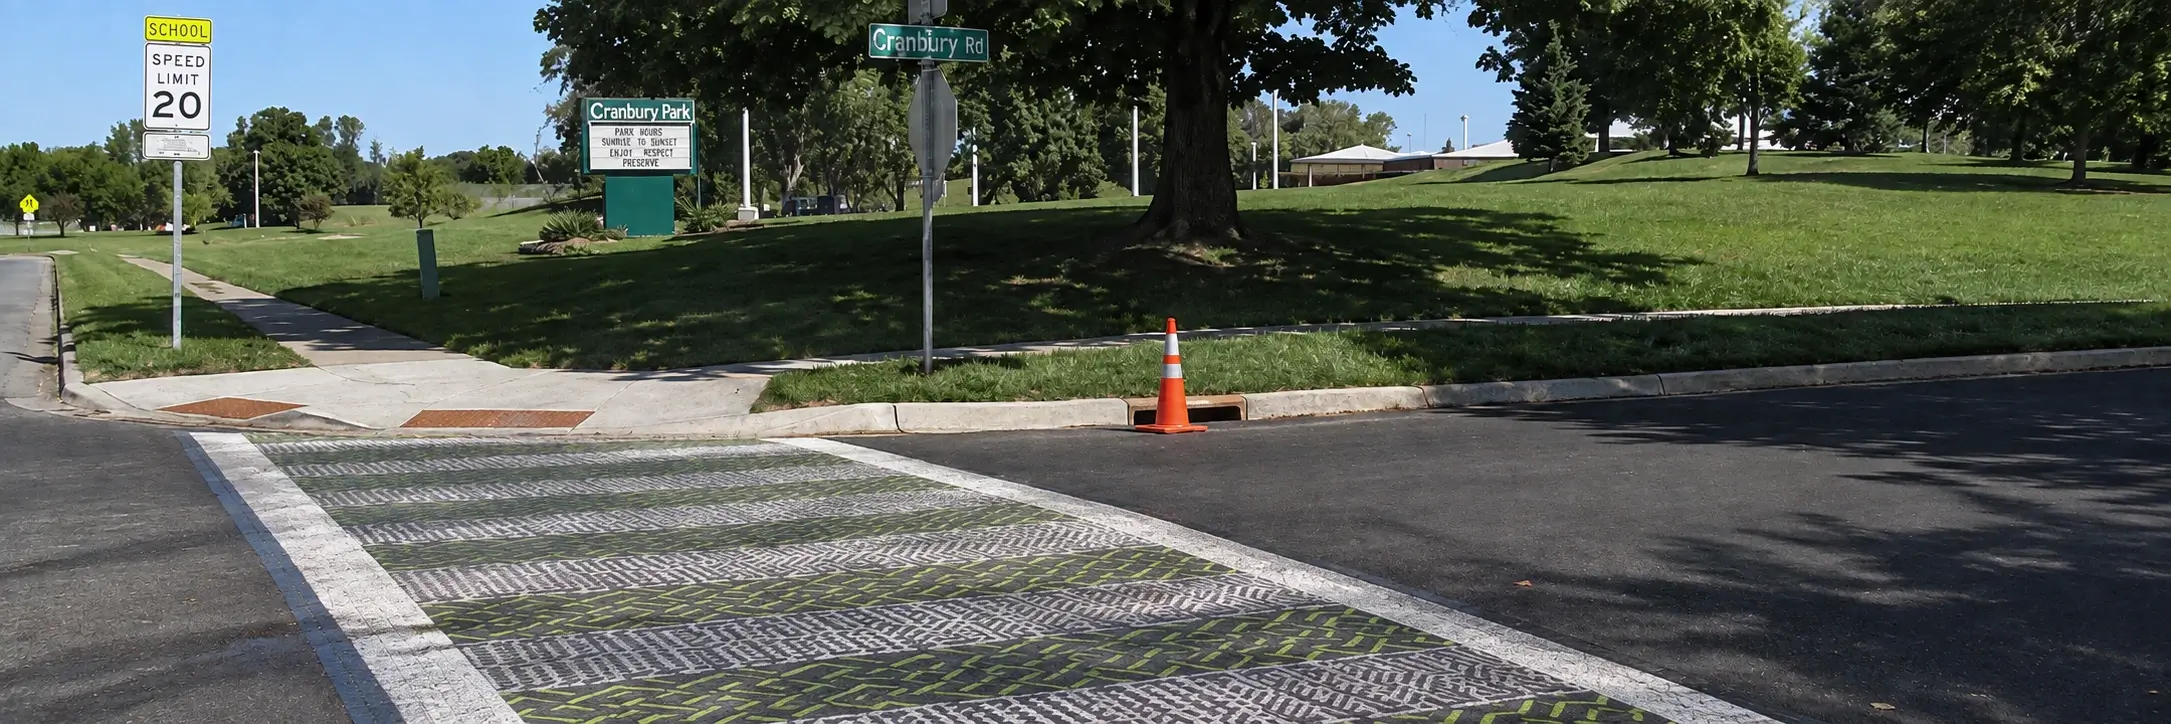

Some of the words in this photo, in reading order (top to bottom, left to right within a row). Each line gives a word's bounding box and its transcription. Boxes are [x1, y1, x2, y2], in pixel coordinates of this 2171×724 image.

[149, 22, 208, 38] SCHOOL
[873, 27, 958, 58] Cranbury
[965, 36, 984, 54] Rd
[152, 53, 205, 68] SPEED
[157, 73, 199, 85] LIMIT
[152, 90, 202, 119] 20
[590, 102, 659, 121] Cranbury
[662, 103, 691, 120] Park
[614, 127, 634, 136] PARK
[637, 138, 646, 146] TO
[643, 148, 673, 157] RESPECT
[622, 158, 660, 167] PRESERVE
